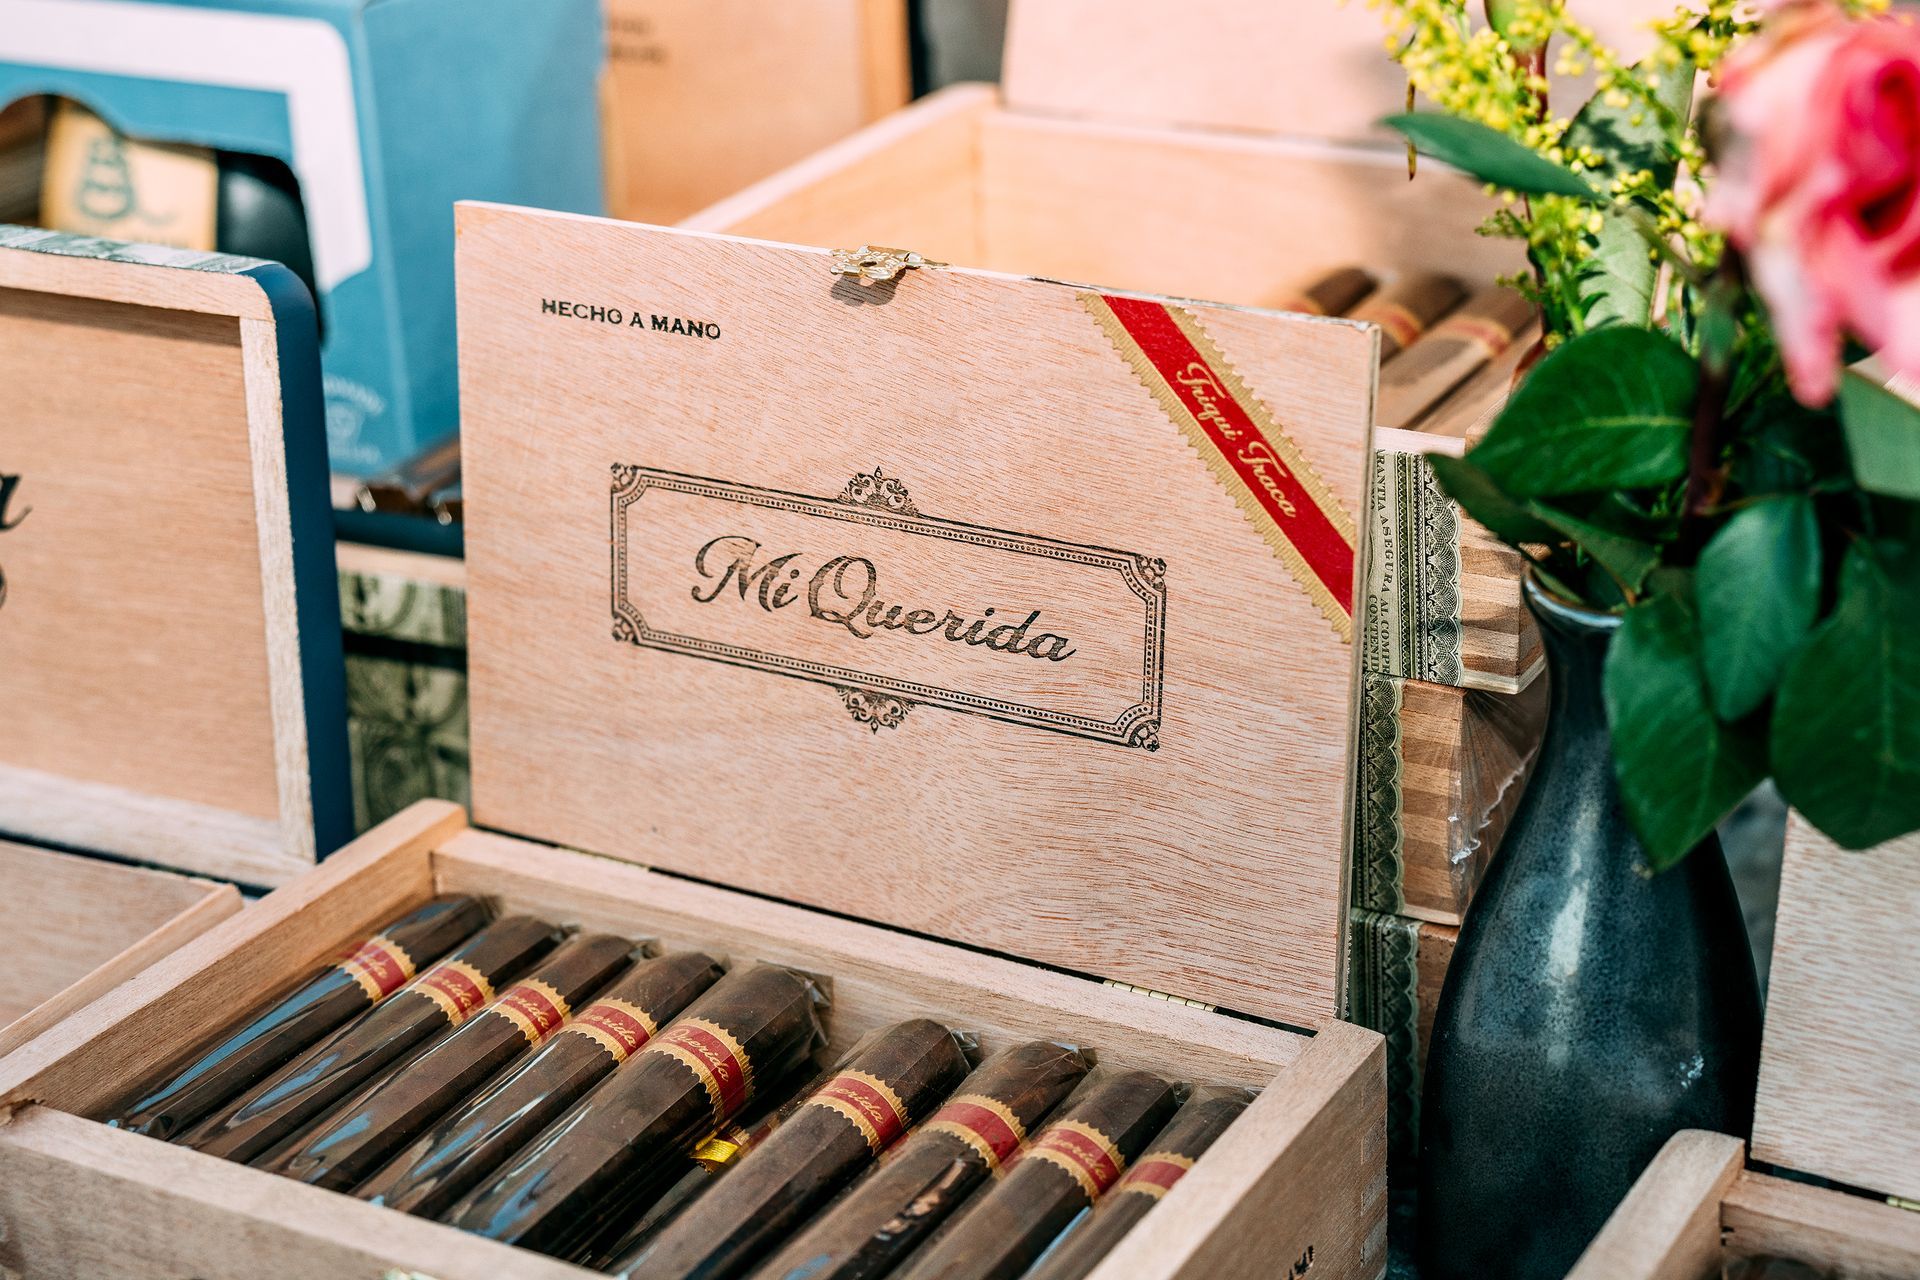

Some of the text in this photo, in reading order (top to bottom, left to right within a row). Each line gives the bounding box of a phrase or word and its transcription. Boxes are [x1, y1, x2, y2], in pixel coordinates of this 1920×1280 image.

[541, 298, 721, 340] HECHO A MANO
[1237, 441, 1297, 518] Traca
[1380, 515, 1394, 593] ASEGURA
[691, 535, 1077, 661] Mi Querida
[1380, 598, 1389, 617] AL
